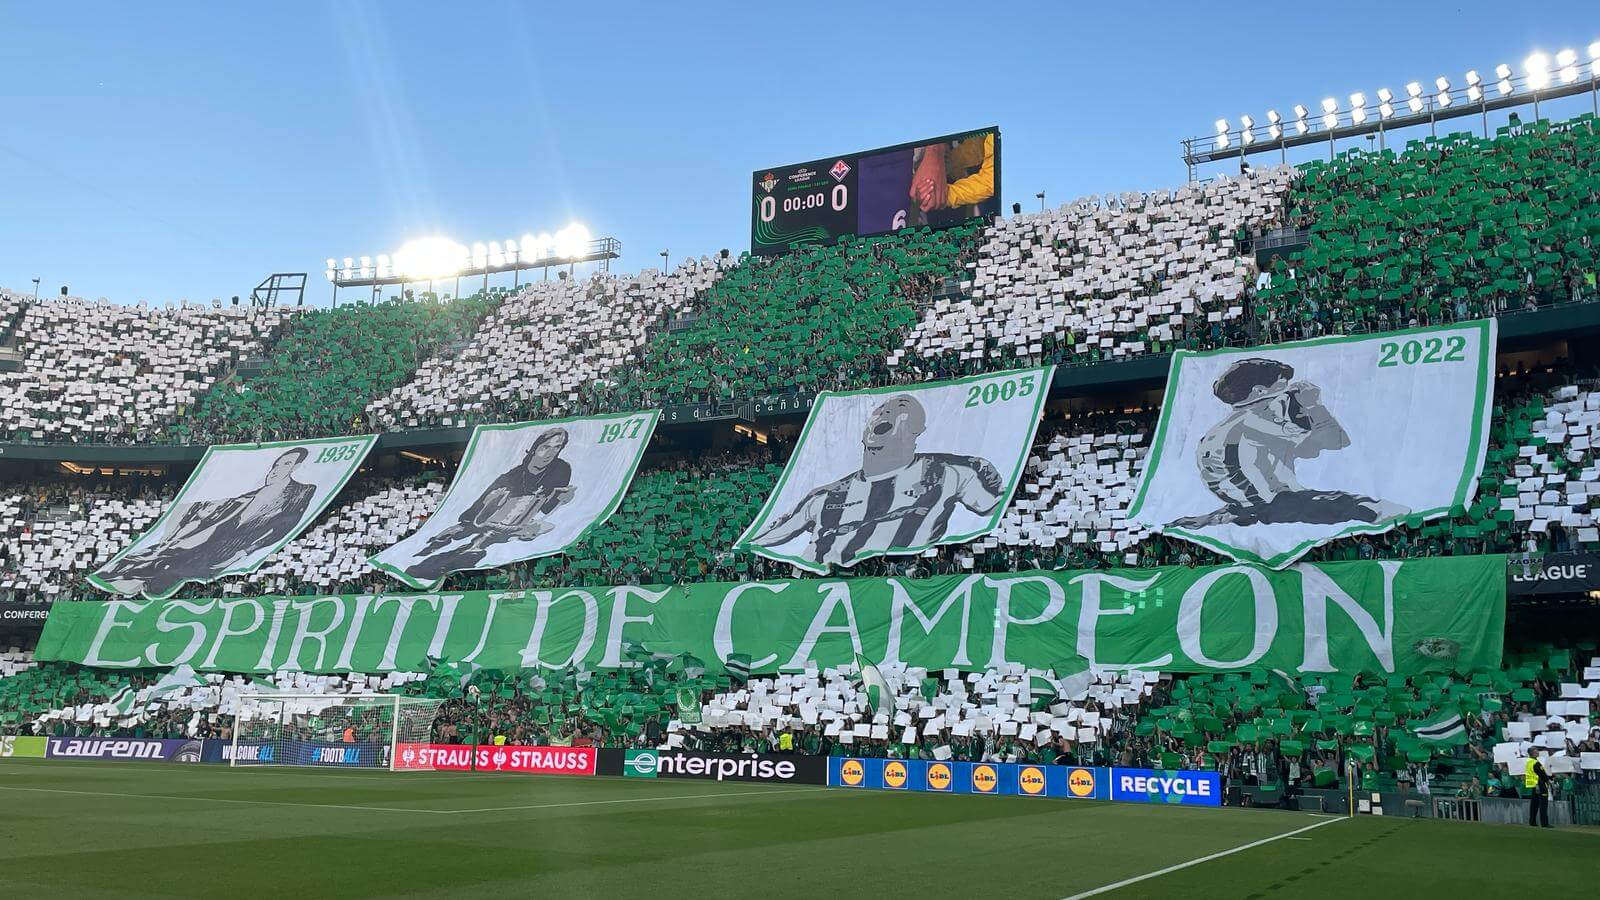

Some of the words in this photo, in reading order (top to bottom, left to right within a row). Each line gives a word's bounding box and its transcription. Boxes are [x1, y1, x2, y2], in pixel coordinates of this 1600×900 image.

[760, 195, 776, 222] 0
[783, 192, 825, 213] 00:00
[831, 184, 848, 211] 0
[1378, 336, 1466, 368] 2022
[965, 375, 1034, 408] 2005
[598, 418, 645, 443] 1977
[314, 443, 360, 463] 1935
[82, 593, 505, 670] ESPIRITU
[518, 585, 672, 670] DE
[713, 560, 1403, 672] CAMPEON
[222, 745, 259, 760] WLCOME
[418, 749, 489, 767] STRAUSS
[511, 749, 588, 769] STRAUSS
[626, 752, 796, 781] enterprise
[1121, 776, 1210, 796] RECYCLE
